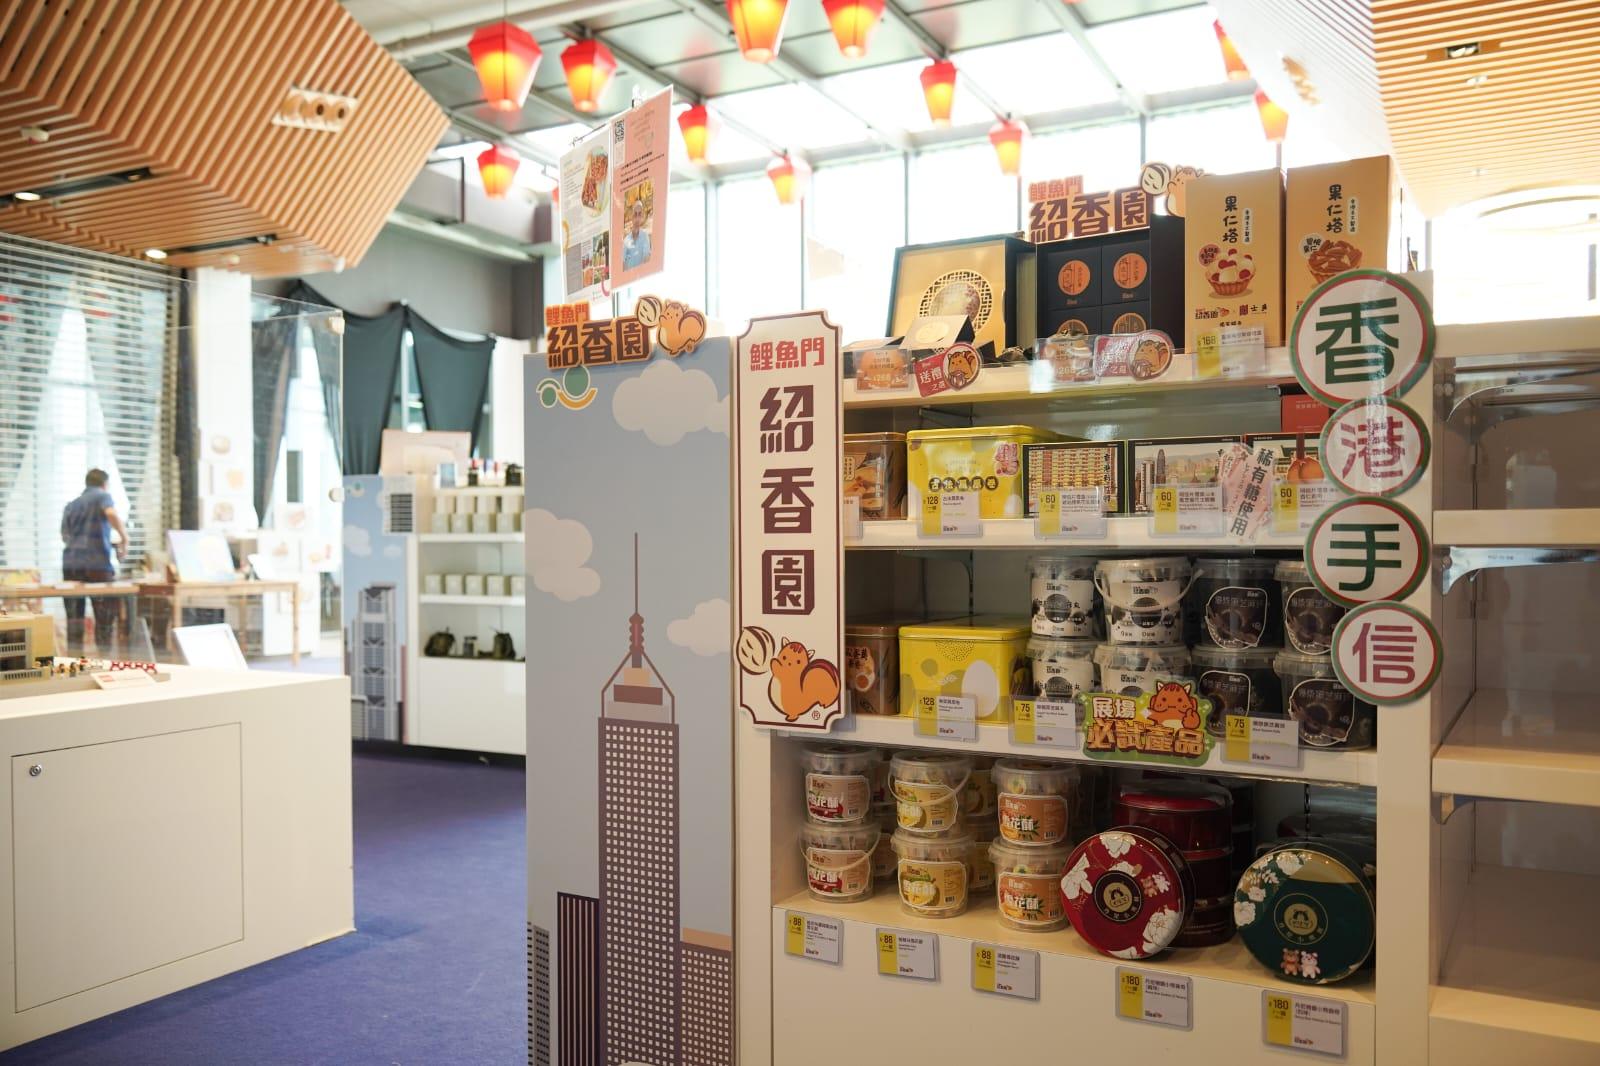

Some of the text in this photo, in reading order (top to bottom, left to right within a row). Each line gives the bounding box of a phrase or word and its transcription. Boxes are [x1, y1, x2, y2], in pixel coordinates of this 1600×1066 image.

[1030, 176, 1083, 201] 鯉魚門
[1325, 184, 1343, 233] 果仁塔
[1030, 187, 1153, 243] 紹香園
[1222, 195, 1239, 243] 果仁塔
[546, 303, 589, 326] 鯉魚門
[548, 317, 650, 367] 紹香園
[750, 337, 824, 371] 鯉魚門
[920, 366, 943, 385] 送禮
[760, 385, 815, 615] 紹香園
[1316, 297, 1417, 685] 香港手信
[1093, 697, 1137, 720] 展場
[1087, 719, 1205, 758] 必試產品
